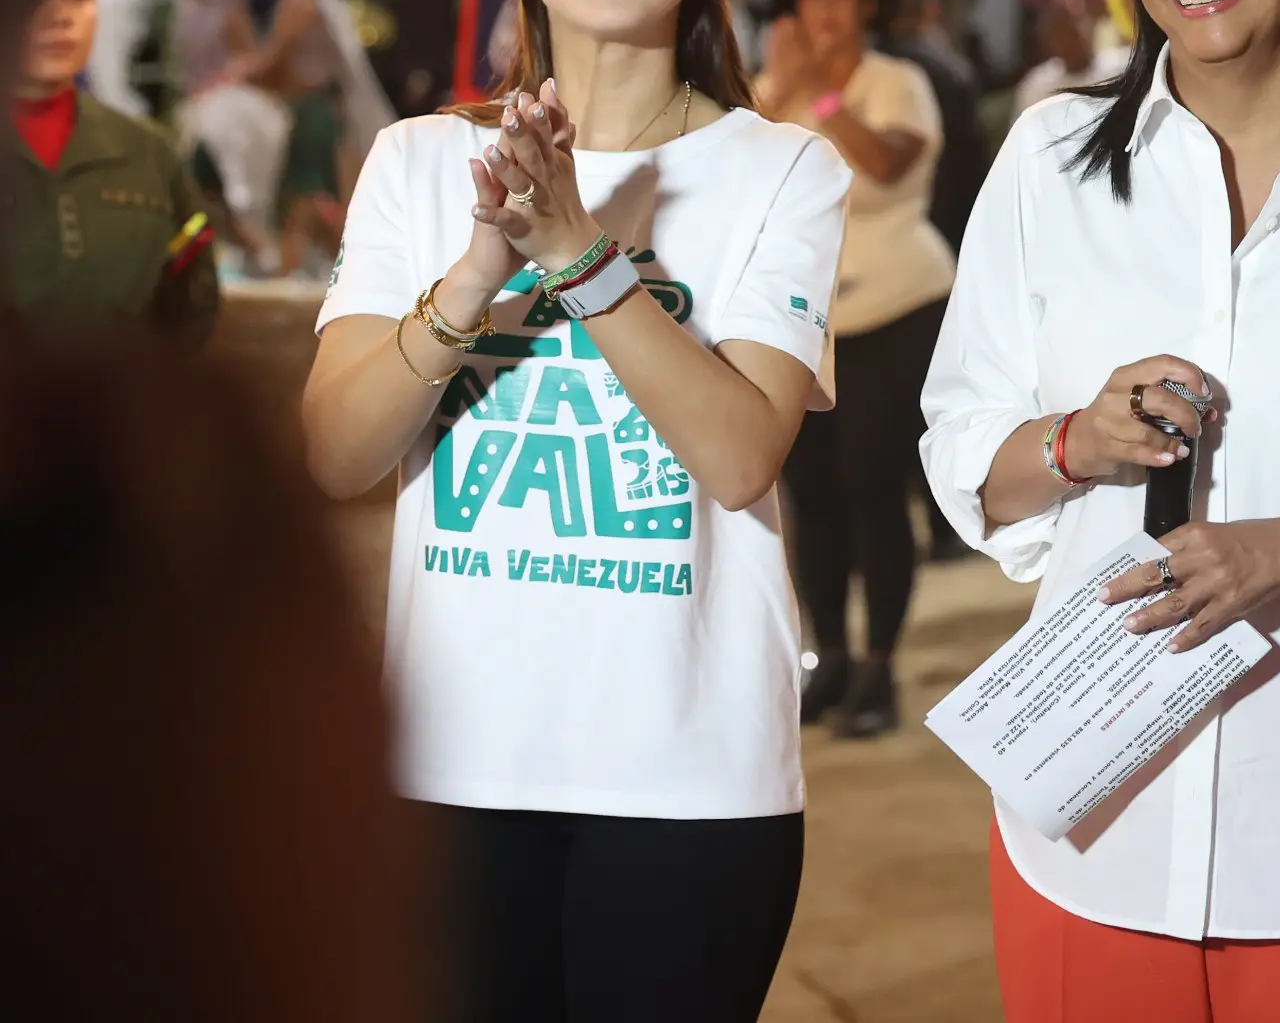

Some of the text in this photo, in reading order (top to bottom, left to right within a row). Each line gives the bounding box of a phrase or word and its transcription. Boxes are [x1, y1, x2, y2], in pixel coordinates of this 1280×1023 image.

[570, 256, 590, 274] SAN
[431, 426, 693, 540] VAL
[425, 544, 693, 596] VIVA VENEZUELA
[1086, 576, 1098, 586] Los
[1071, 595, 1087, 610] como
[1086, 596, 1099, 606] dos
[1049, 610, 1071, 631] desfiles
[1058, 607, 1086, 633] festivales
[1115, 603, 1133, 621] playas
[1099, 621, 1115, 636] aptas
[1018, 625, 1045, 652] Monseñor
[1032, 638, 1042, 648] los
[1034, 632, 1057, 657] playeros
[1085, 635, 1099, 649] para
[1096, 631, 1127, 660] Falconiana
[1043, 640, 1073, 669] municipios
[1146, 654, 1157, 665] una
[1209, 642, 1228, 659] Moruy
[1002, 647, 1032, 677] municipios
[1053, 657, 1077, 681] bañistas
[1122, 648, 1153, 677] Carnavales
[1231, 658, 1244, 672] para
[1011, 667, 1025, 679] Villa
[1033, 669, 1043, 680] del
[1112, 665, 1146, 698] movilización
[1184, 670, 1198, 684] años
[1185, 667, 1214, 692] VICTORIA
[978, 676, 1004, 698] Miranda,
[988, 680, 1011, 699] Marina,
[1013, 678, 1034, 697] estado.
[1062, 672, 1085, 693] Turismo
[1106, 677, 1123, 692] 2025.
[1133, 680, 1153, 699] DATOS
[1209, 678, 1224, 692] Zona
[1025, 690, 1055, 718] municipios
[1032, 689, 1046, 701] todo
[1124, 698, 1134, 708] DE
[1160, 691, 1176, 706] edad.
[1194, 692, 1210, 706] Libre
[958, 700, 979, 717] Colina,
[1180, 705, 1194, 719] para
[1007, 725, 1028, 745] reporta
[1009, 723, 1021, 734] 122
[1133, 714, 1163, 741] integrante
[1149, 725, 1174, 747] Fomento
[1032, 747, 1060, 772] visitantes
[1096, 759, 1115, 775] Locos
